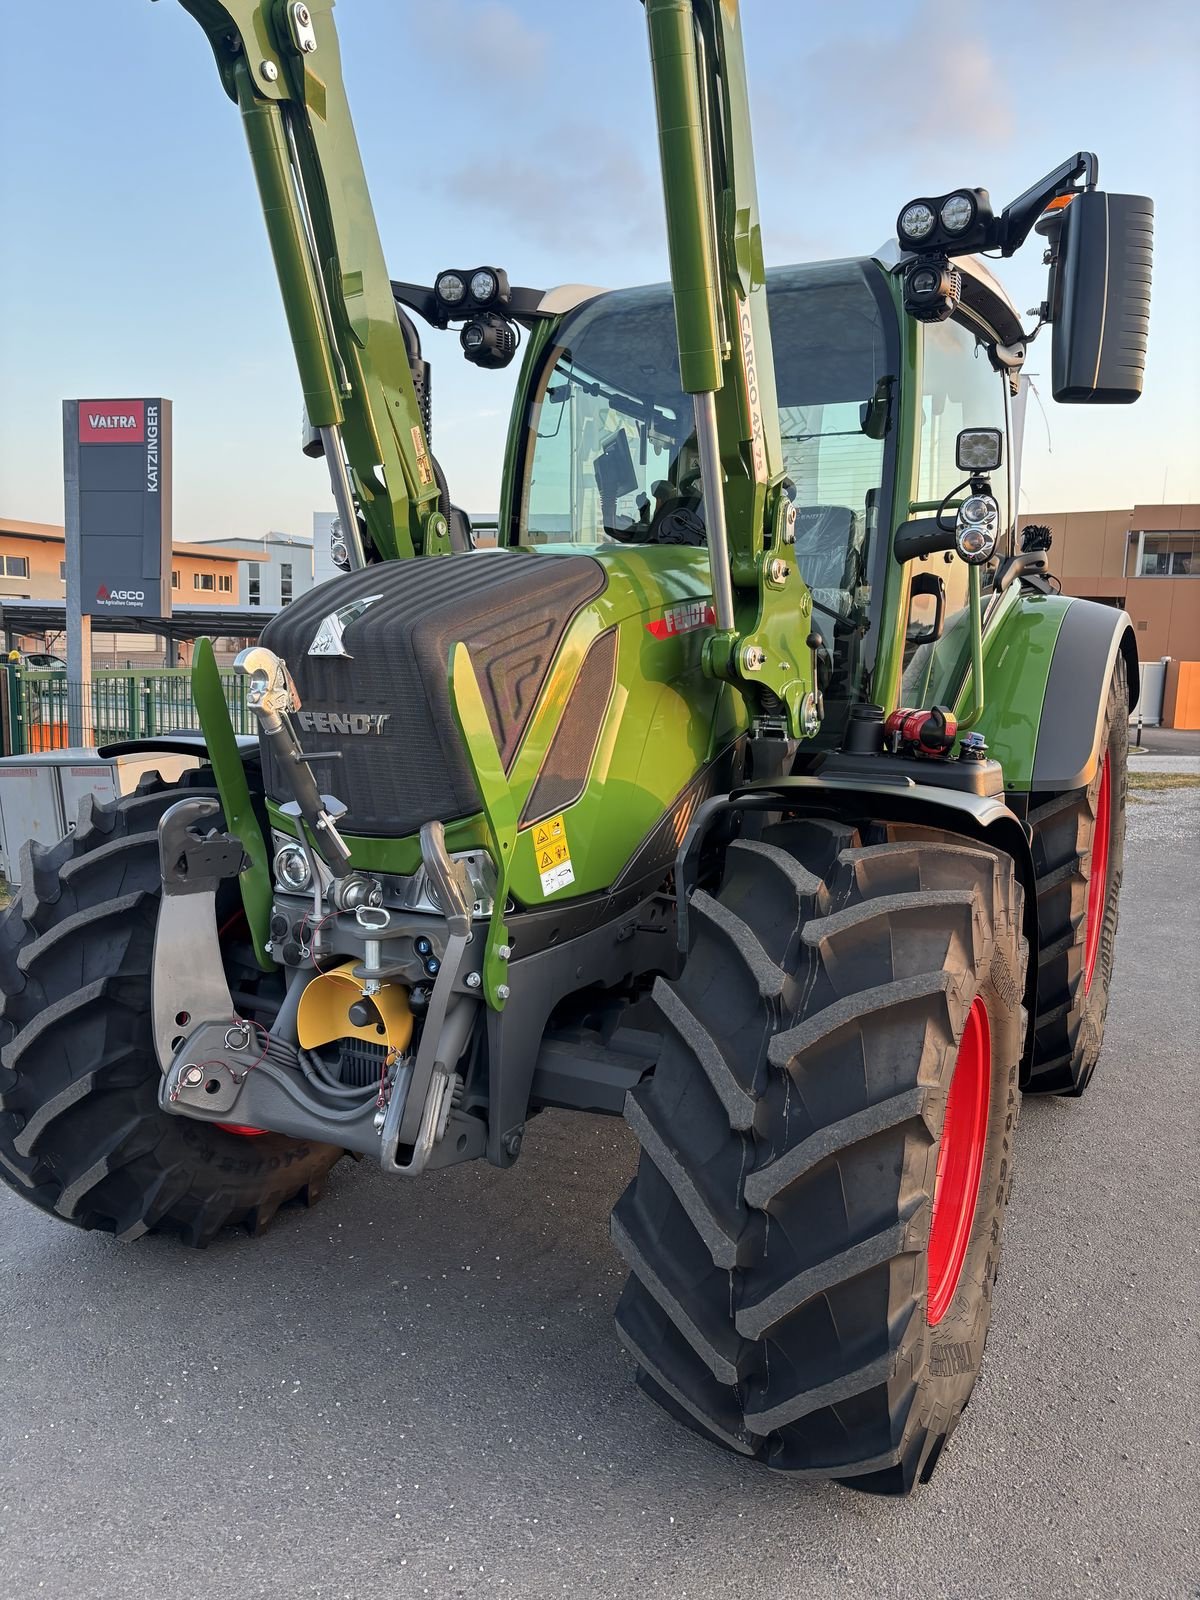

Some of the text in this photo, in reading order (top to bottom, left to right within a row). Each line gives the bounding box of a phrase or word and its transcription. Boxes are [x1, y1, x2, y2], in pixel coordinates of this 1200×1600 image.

[742, 313, 758, 405] CARGO
[88, 414, 137, 428] VALTRA
[752, 411, 762, 443] 4X
[147, 406, 158, 492] KATZINGER
[755, 447, 763, 471] 75
[110, 590, 145, 600] AGCO
[664, 601, 707, 632] FENDT
[297, 711, 391, 735] FENDT
